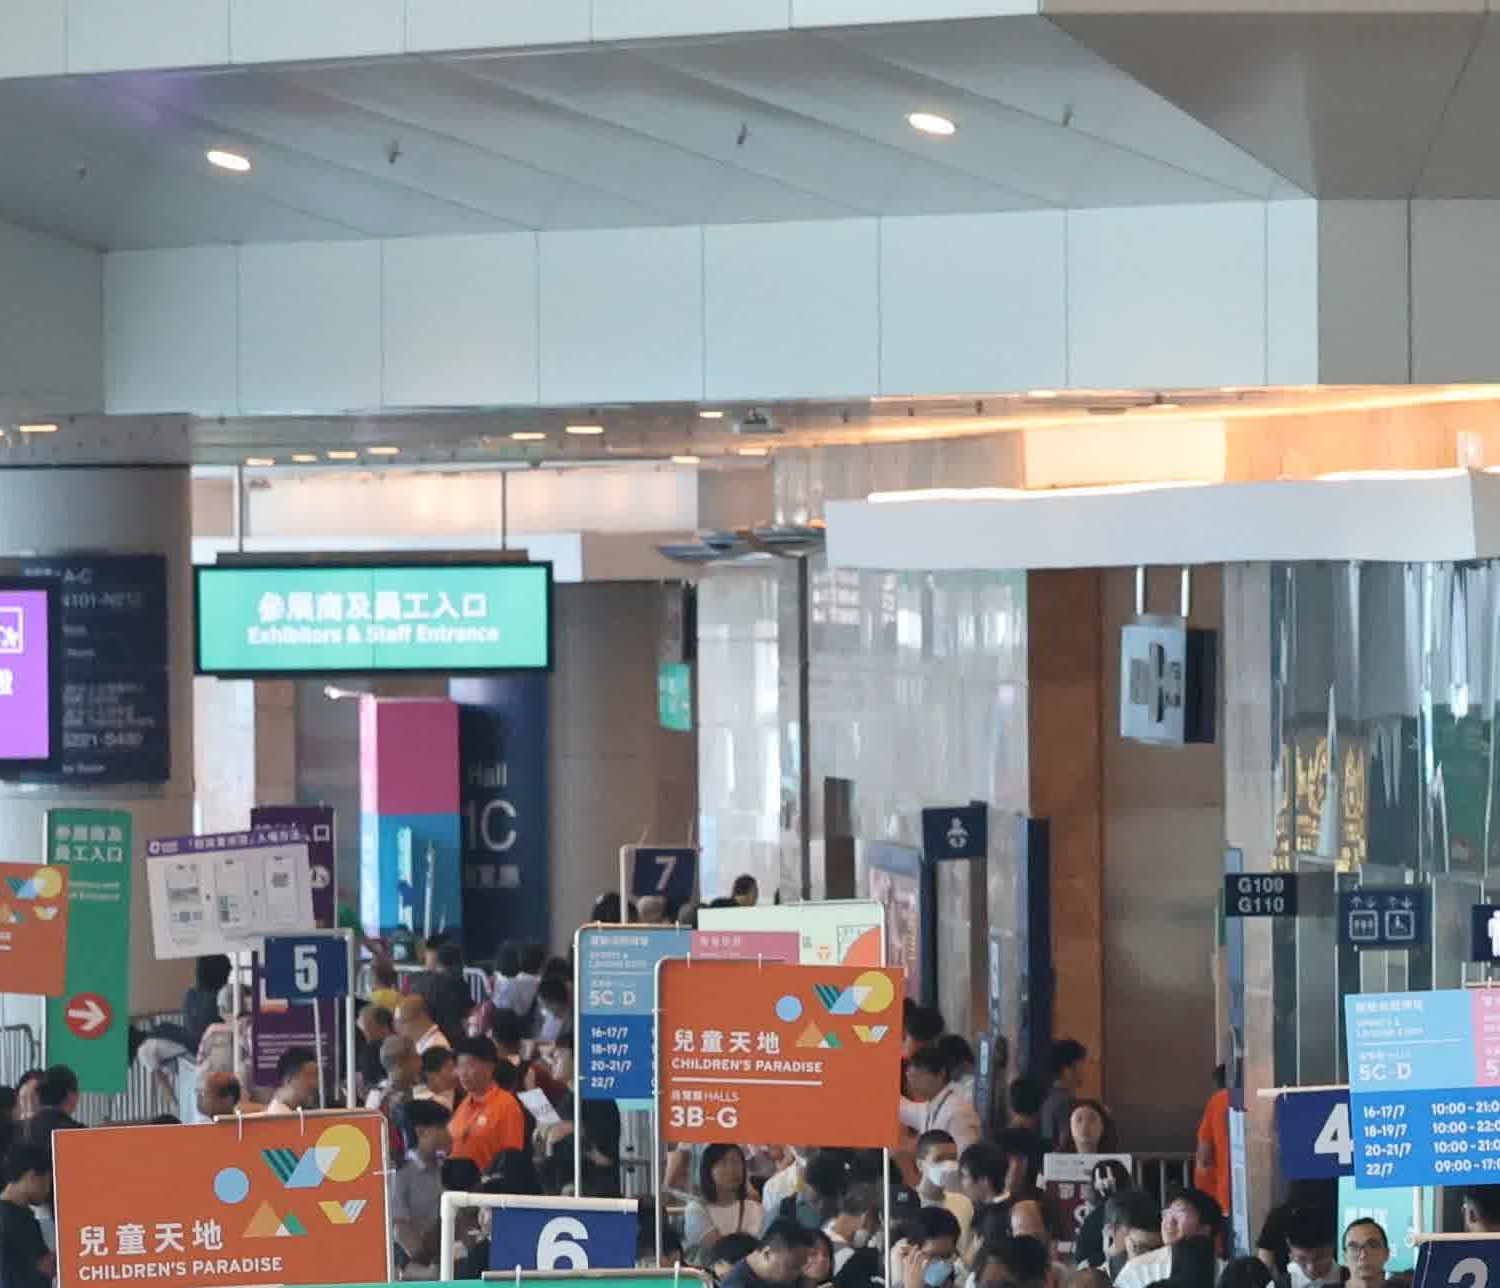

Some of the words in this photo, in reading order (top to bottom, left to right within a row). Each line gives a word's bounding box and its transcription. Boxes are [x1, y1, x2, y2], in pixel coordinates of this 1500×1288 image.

[247, 624, 342, 644] Exhibitors
[346, 625, 362, 643] &
[366, 624, 413, 643] Staff
[417, 624, 500, 643] Entrance
[655, 856, 677, 891] 7
[294, 944, 319, 992] 5
[673, 1028, 781, 1055] 兒童天地
[671, 1056, 750, 1072] CHILDREN'S
[755, 1059, 823, 1073] PARADISE
[670, 1104, 738, 1128] 3B-G
[1363, 1104, 1405, 1119] 16-17/7
[1314, 1103, 1352, 1164] 4
[1364, 1124, 1408, 1139] 18-19/7
[1364, 1143, 1413, 1159] 20-21/7
[1365, 1162, 1395, 1178] 22/7
[79, 1219, 224, 1257] 兒童天地
[536, 1217, 589, 1271] 6
[79, 1261, 187, 1281] CHILDREN'S
[192, 1256, 284, 1276] PARADISE
